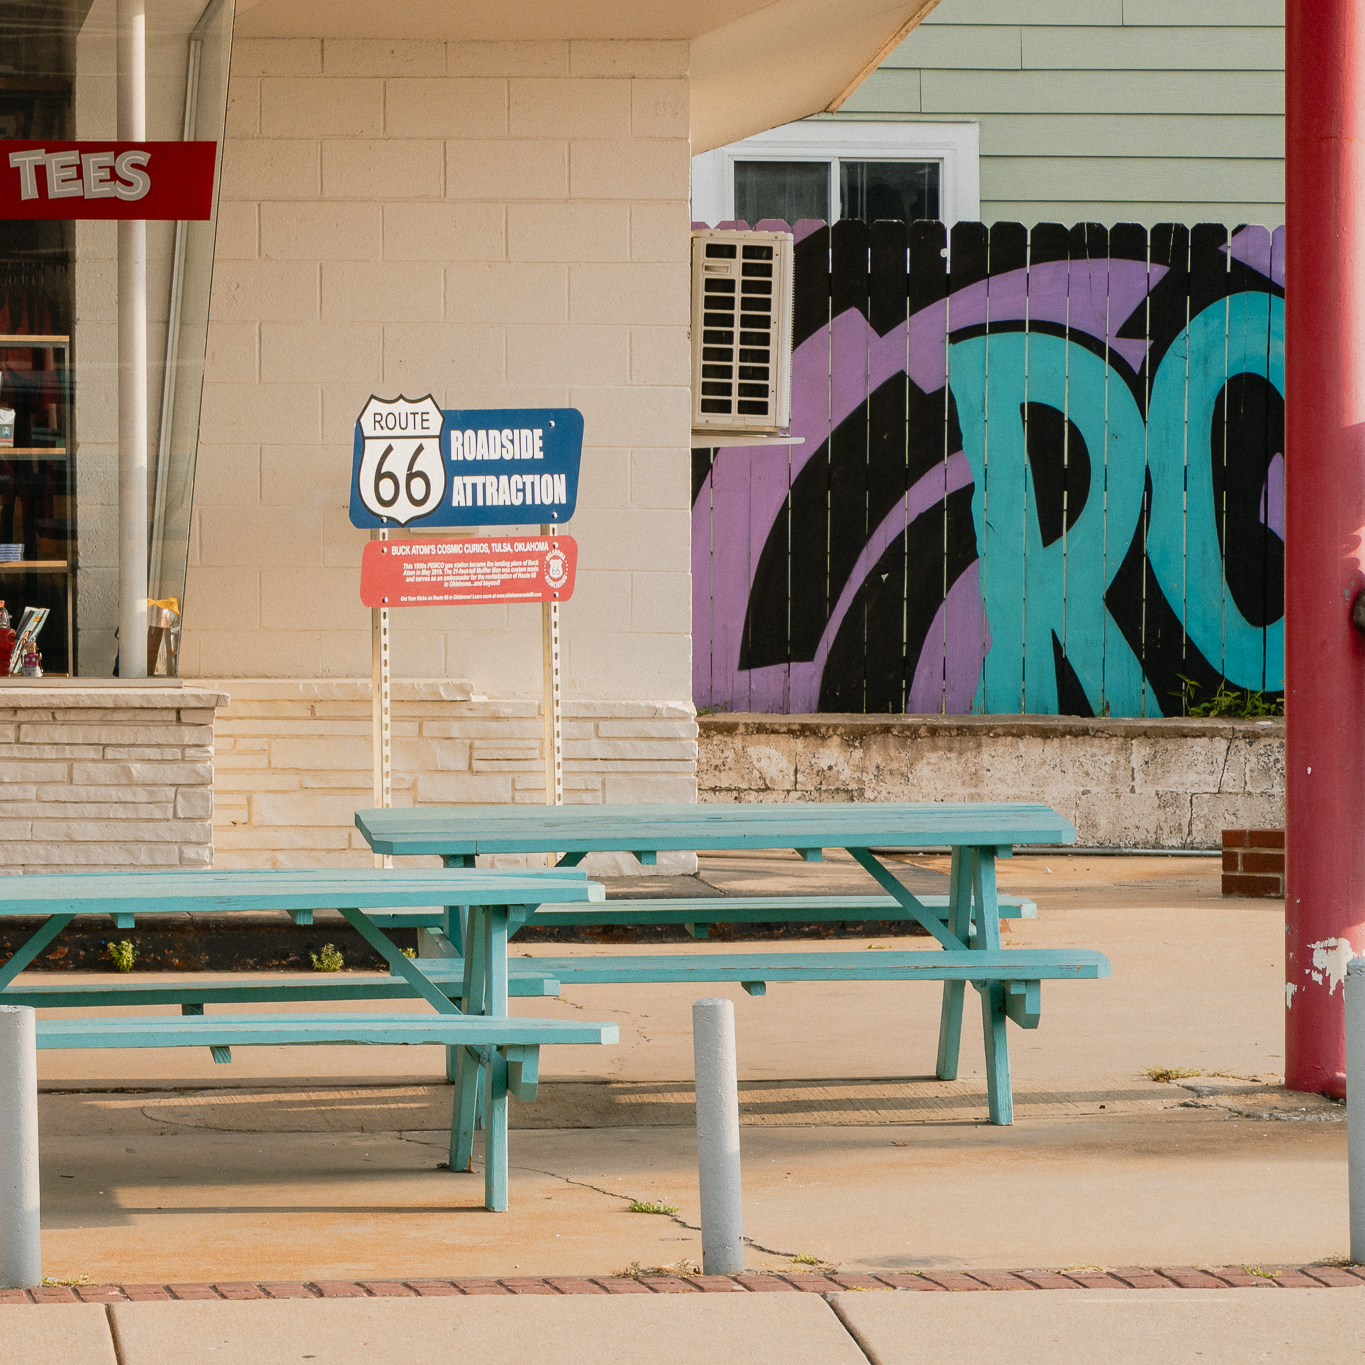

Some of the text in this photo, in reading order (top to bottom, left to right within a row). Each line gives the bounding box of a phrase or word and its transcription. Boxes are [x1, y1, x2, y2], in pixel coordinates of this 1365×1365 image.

[9, 148, 152, 201] TEES
[373, 411, 430, 431] ROUTE
[450, 429, 544, 461] ROADSIDE
[374, 443, 431, 508] 66
[452, 474, 567, 507] ATTRACTION
[391, 541, 549, 556] BUCK ATOM'S COSMIC CURIOS, TULSA, OKLAHOMA
[552, 565, 560, 576] 66
